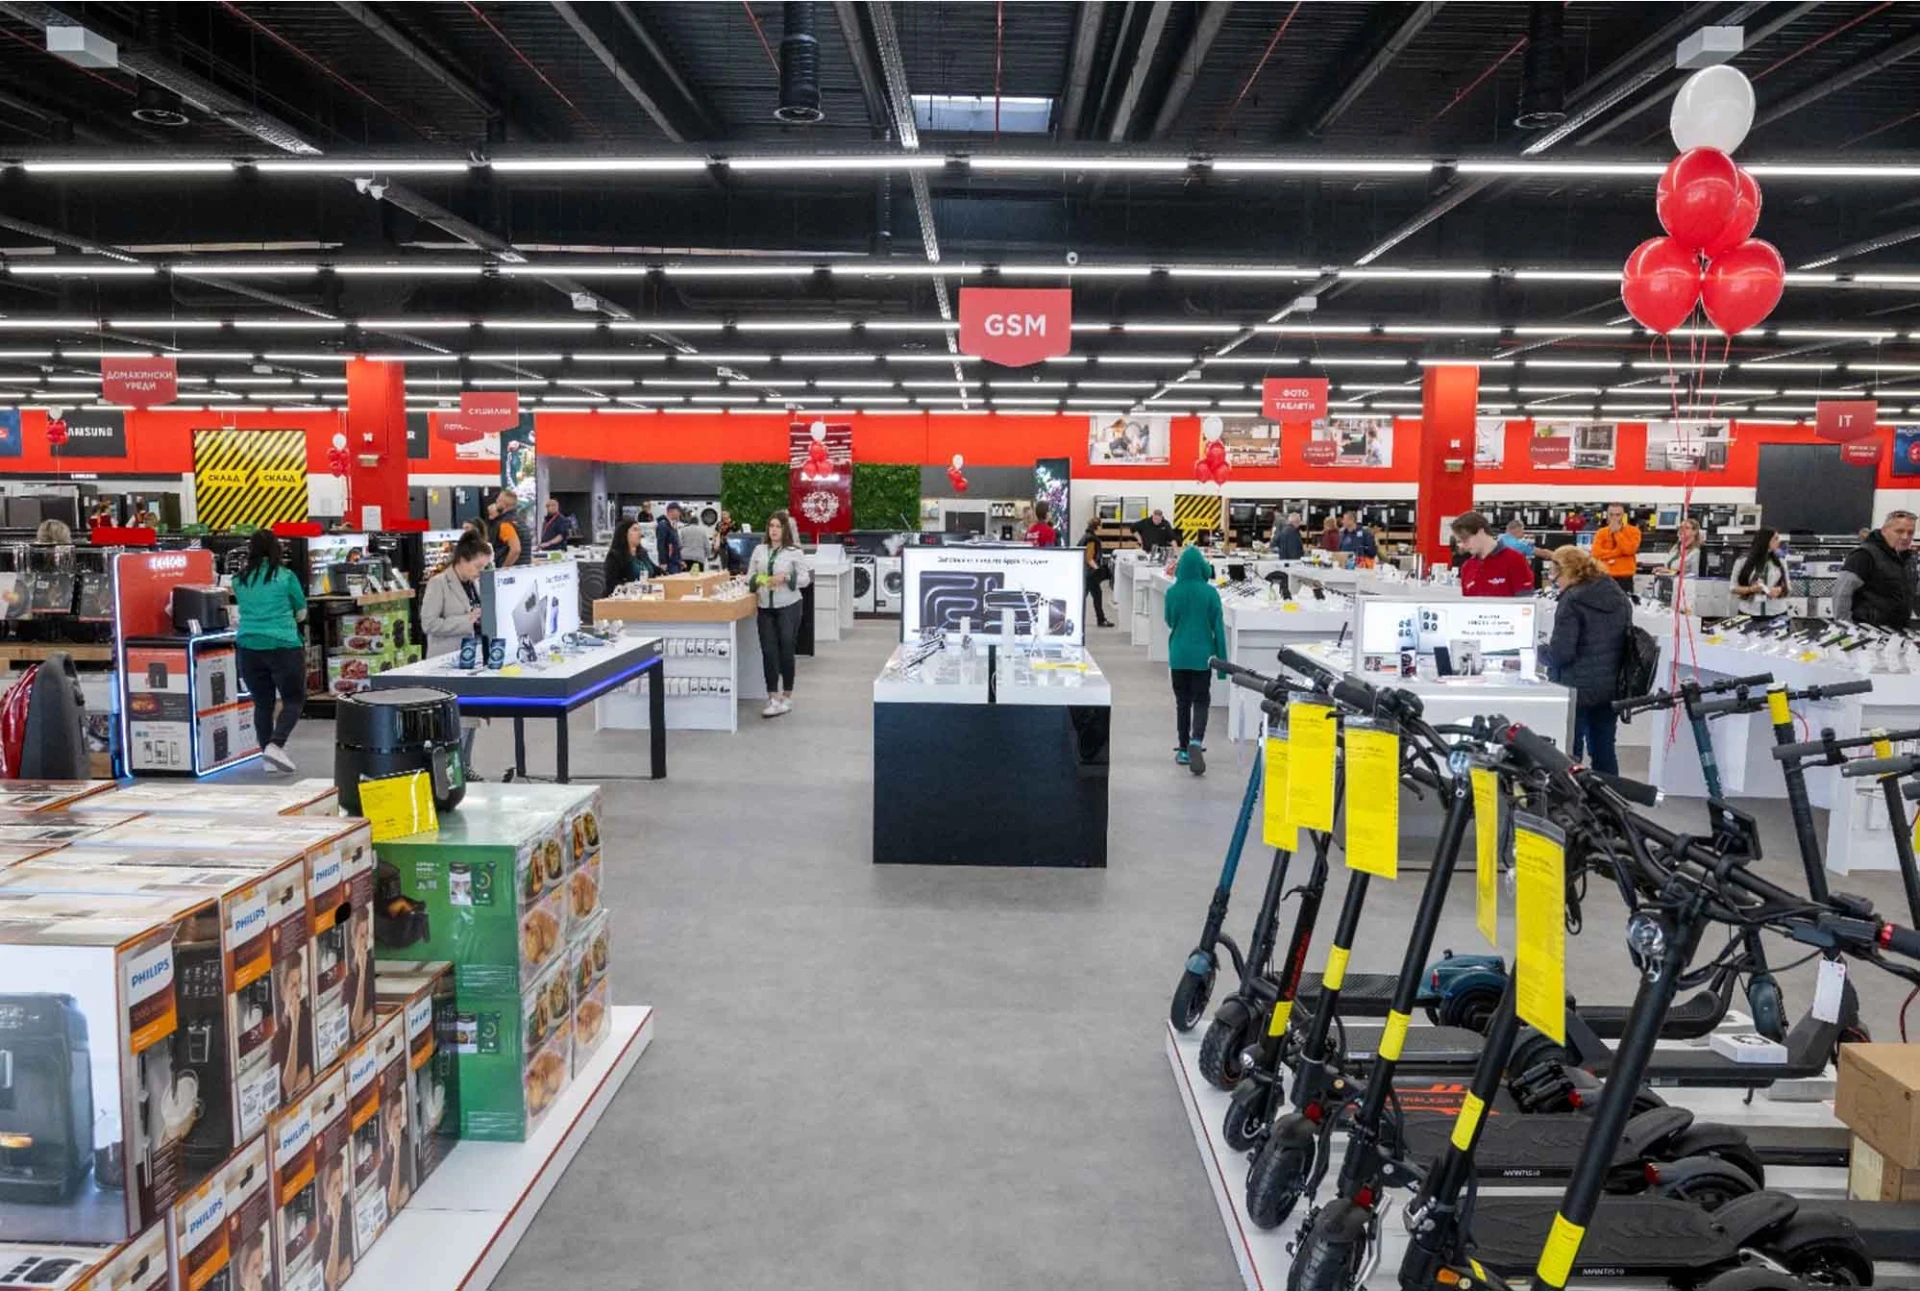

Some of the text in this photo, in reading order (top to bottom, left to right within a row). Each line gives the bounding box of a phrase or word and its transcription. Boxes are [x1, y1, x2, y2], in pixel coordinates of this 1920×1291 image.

[984, 314, 1046, 337] GSM
[107, 371, 173, 380] ДОМАКИНСКИ
[124, 382, 156, 391] УРЕДИ
[1283, 389, 1309, 397] ФОТО
[1275, 402, 1315, 410] ТАБЛЕТИ
[1839, 415, 1853, 427] IT
[67, 427, 113, 437] AMSUNG
[208, 474, 296, 483] СКЛАД СКЛАД
[315, 862, 340, 882] PHILIPS
[235, 907, 266, 932] PHILIPS
[131, 958, 170, 988] PHILIPS
[283, 1121, 311, 1150] PHILIPS
[190, 1198, 224, 1235] PHILIPS
